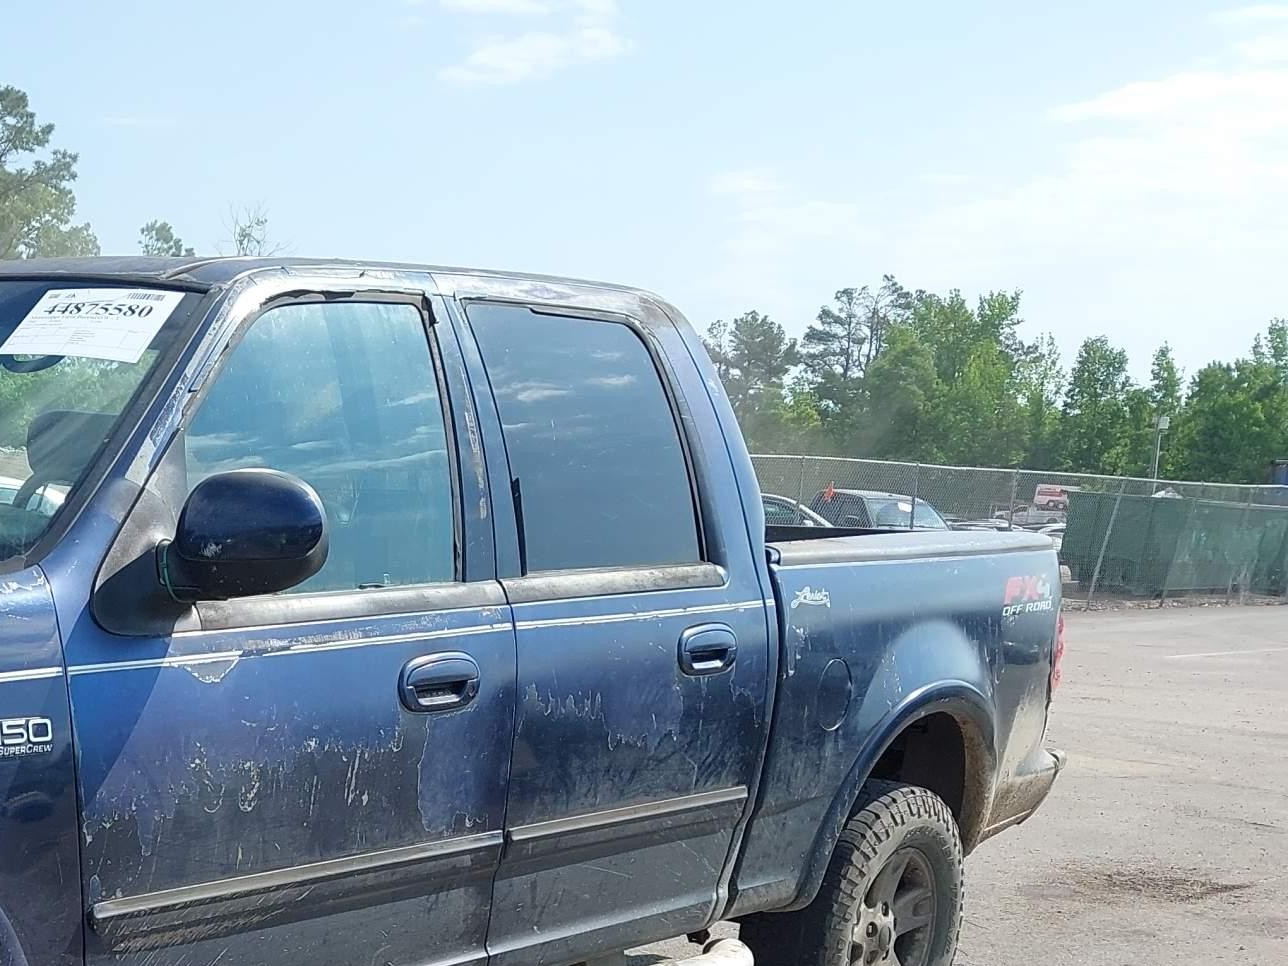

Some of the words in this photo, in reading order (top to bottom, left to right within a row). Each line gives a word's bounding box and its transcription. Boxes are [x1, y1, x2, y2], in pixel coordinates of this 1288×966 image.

[43, 302, 154, 318] 44875580
[1003, 573, 1052, 605] FX4
[1002, 604, 1024, 617] OFF
[1025, 600, 1053, 613] ROAD
